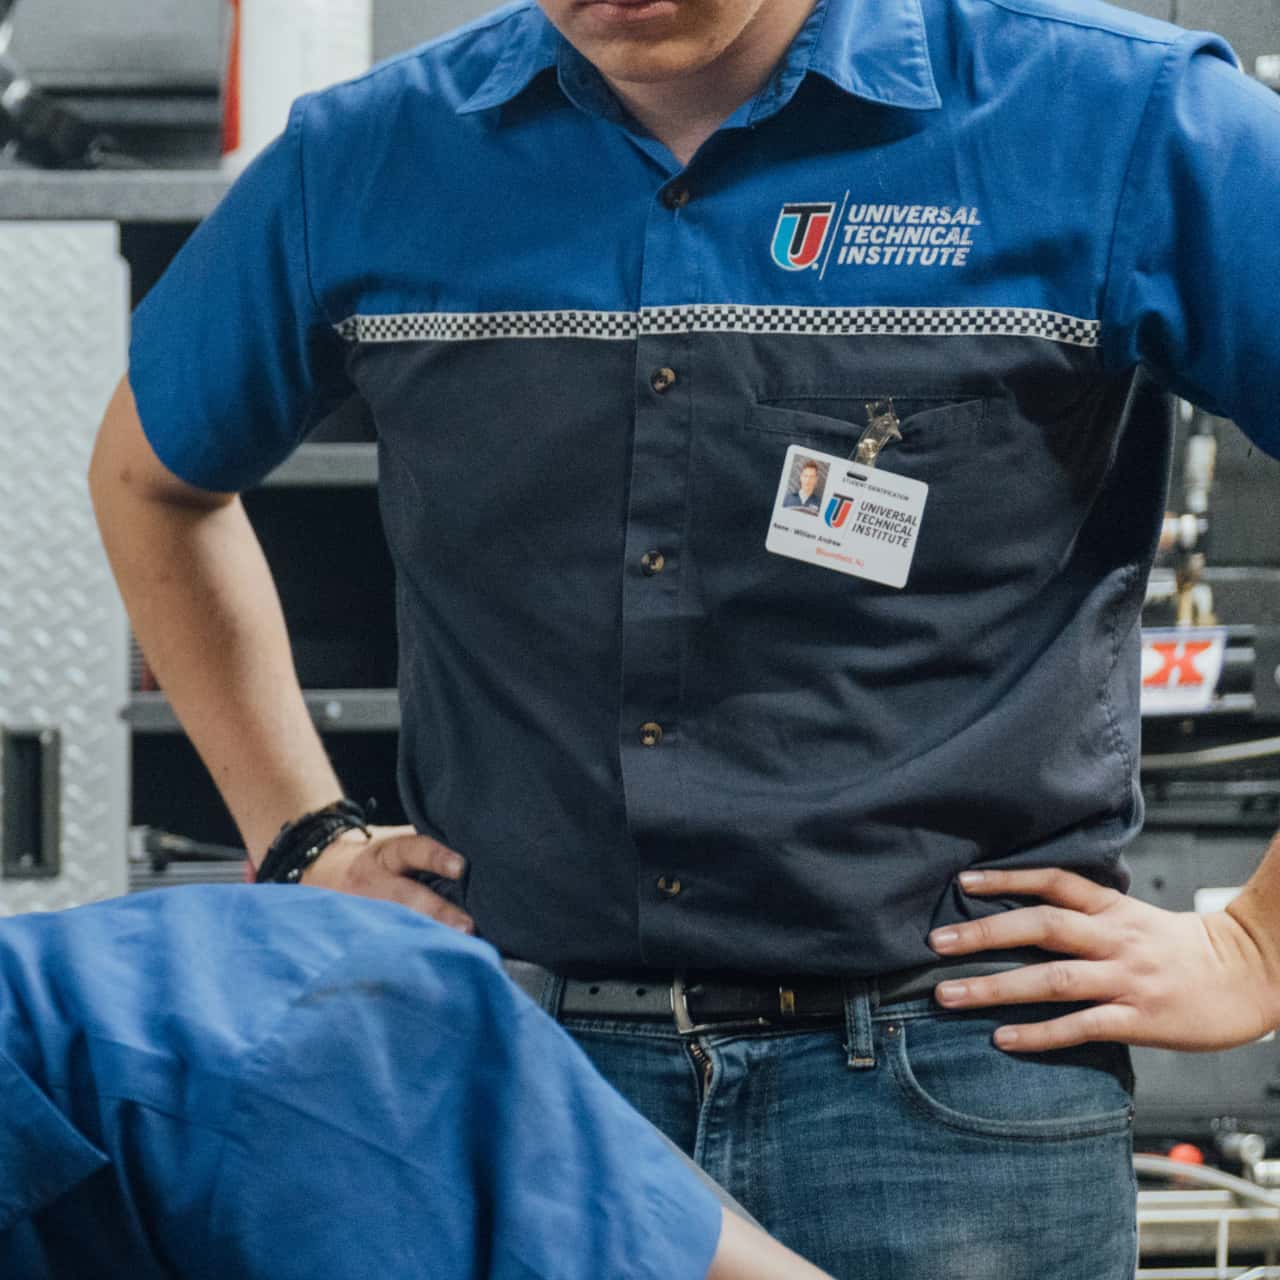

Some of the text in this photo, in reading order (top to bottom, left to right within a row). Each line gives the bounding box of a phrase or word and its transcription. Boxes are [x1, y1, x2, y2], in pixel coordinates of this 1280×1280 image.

[847, 204, 982, 226] UNIVERSAL
[843, 225, 974, 246] TECHNICAL
[837, 246, 970, 266] INSTITUTE
[856, 512, 913, 537] TECHNICAL
[860, 501, 918, 526] UNIVERSAL
[851, 524, 910, 548] INSTITUTE
